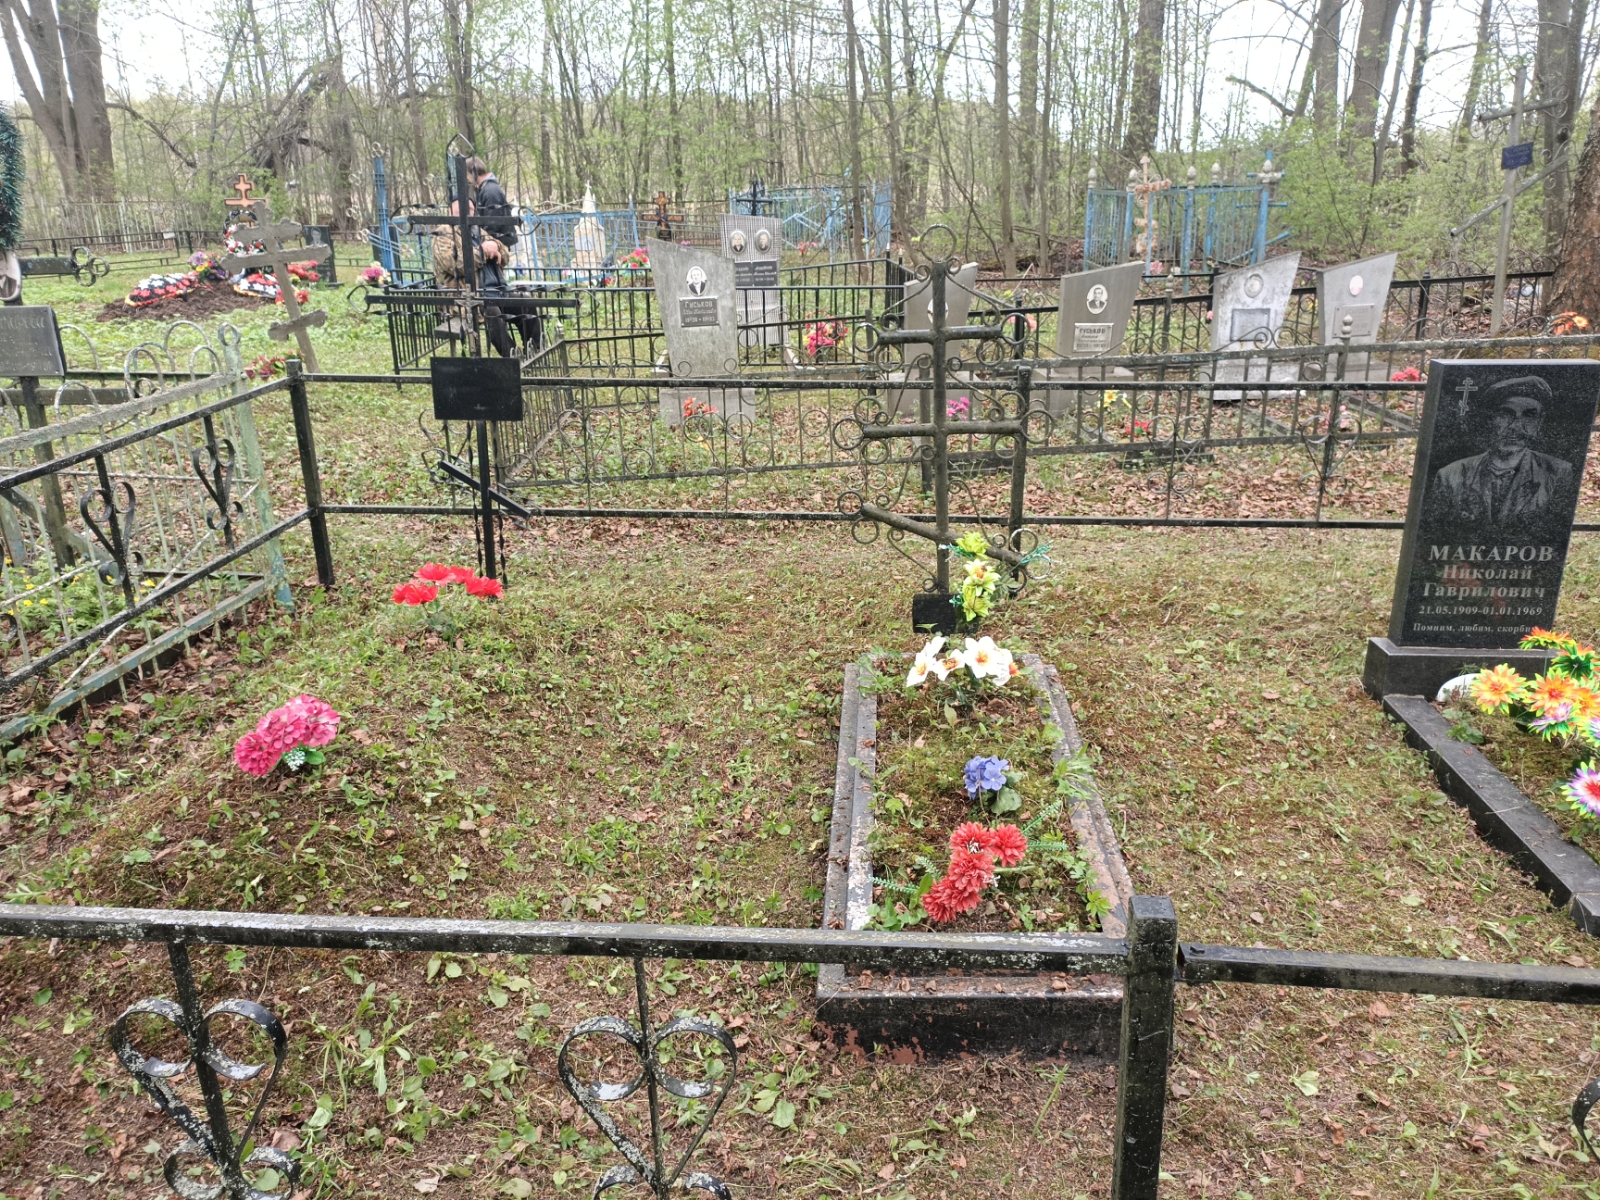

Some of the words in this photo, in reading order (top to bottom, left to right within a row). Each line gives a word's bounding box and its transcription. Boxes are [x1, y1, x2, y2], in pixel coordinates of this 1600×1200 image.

[1428, 545, 1554, 562] МАКАРОВ
[1442, 564, 1533, 580] Николай
[1423, 582, 1546, 601] Гаврилович
[1418, 605, 1543, 616] 21.05.1909-01.01.1969
[1413, 623, 1455, 632] Помним,
[1458, 624, 1494, 633] любим,
[1497, 624, 1531, 634] скорби
